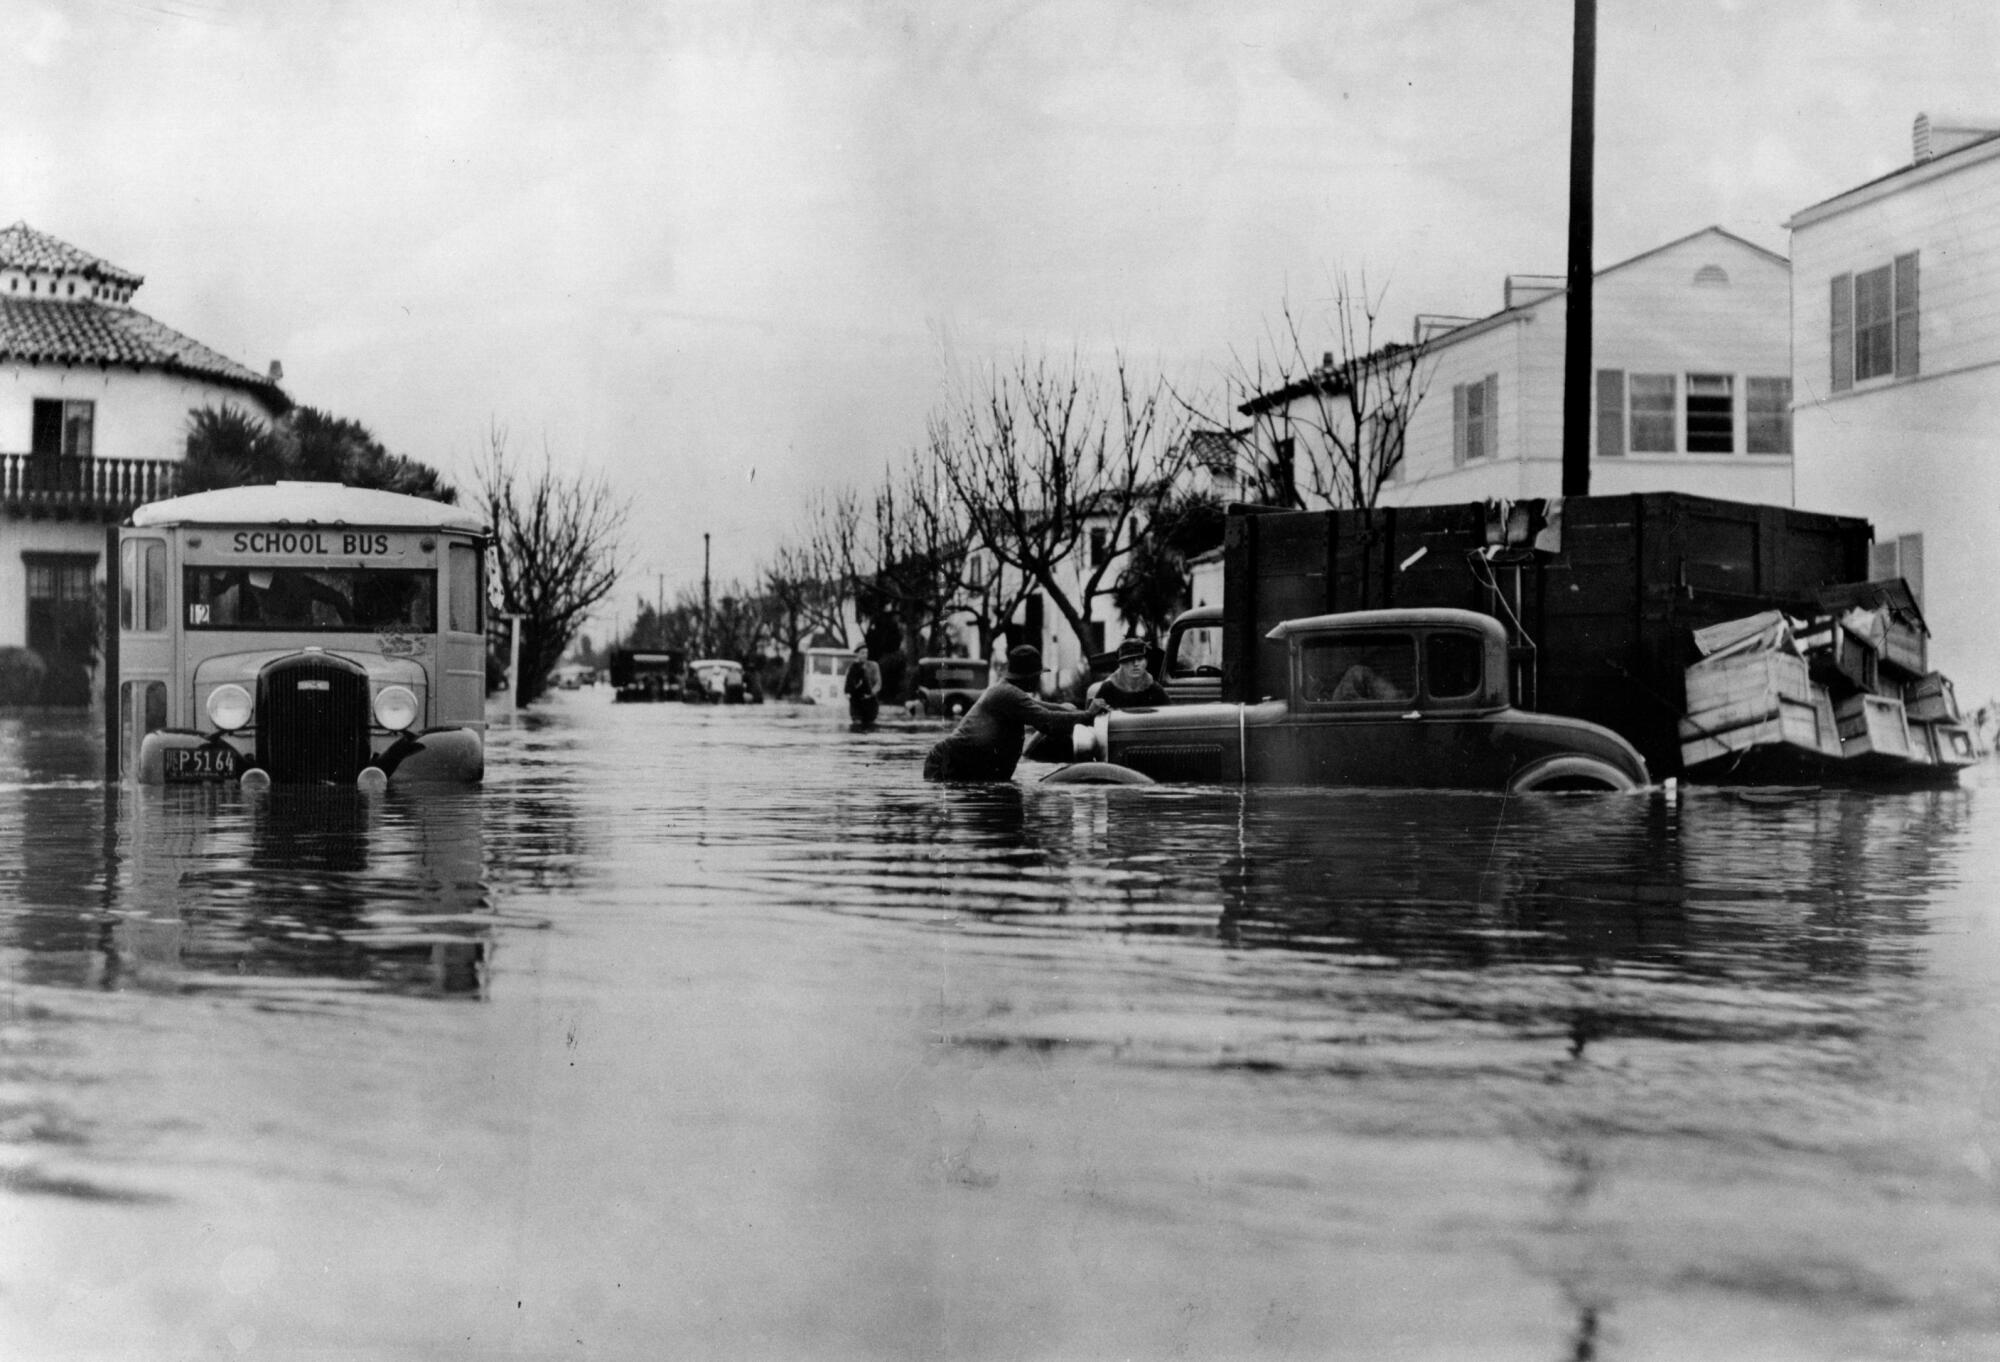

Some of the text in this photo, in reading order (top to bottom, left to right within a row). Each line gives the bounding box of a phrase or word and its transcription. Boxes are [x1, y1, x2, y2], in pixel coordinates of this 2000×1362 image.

[233, 532, 389, 554] SCHOOL BUS
[192, 604, 209, 624] 12
